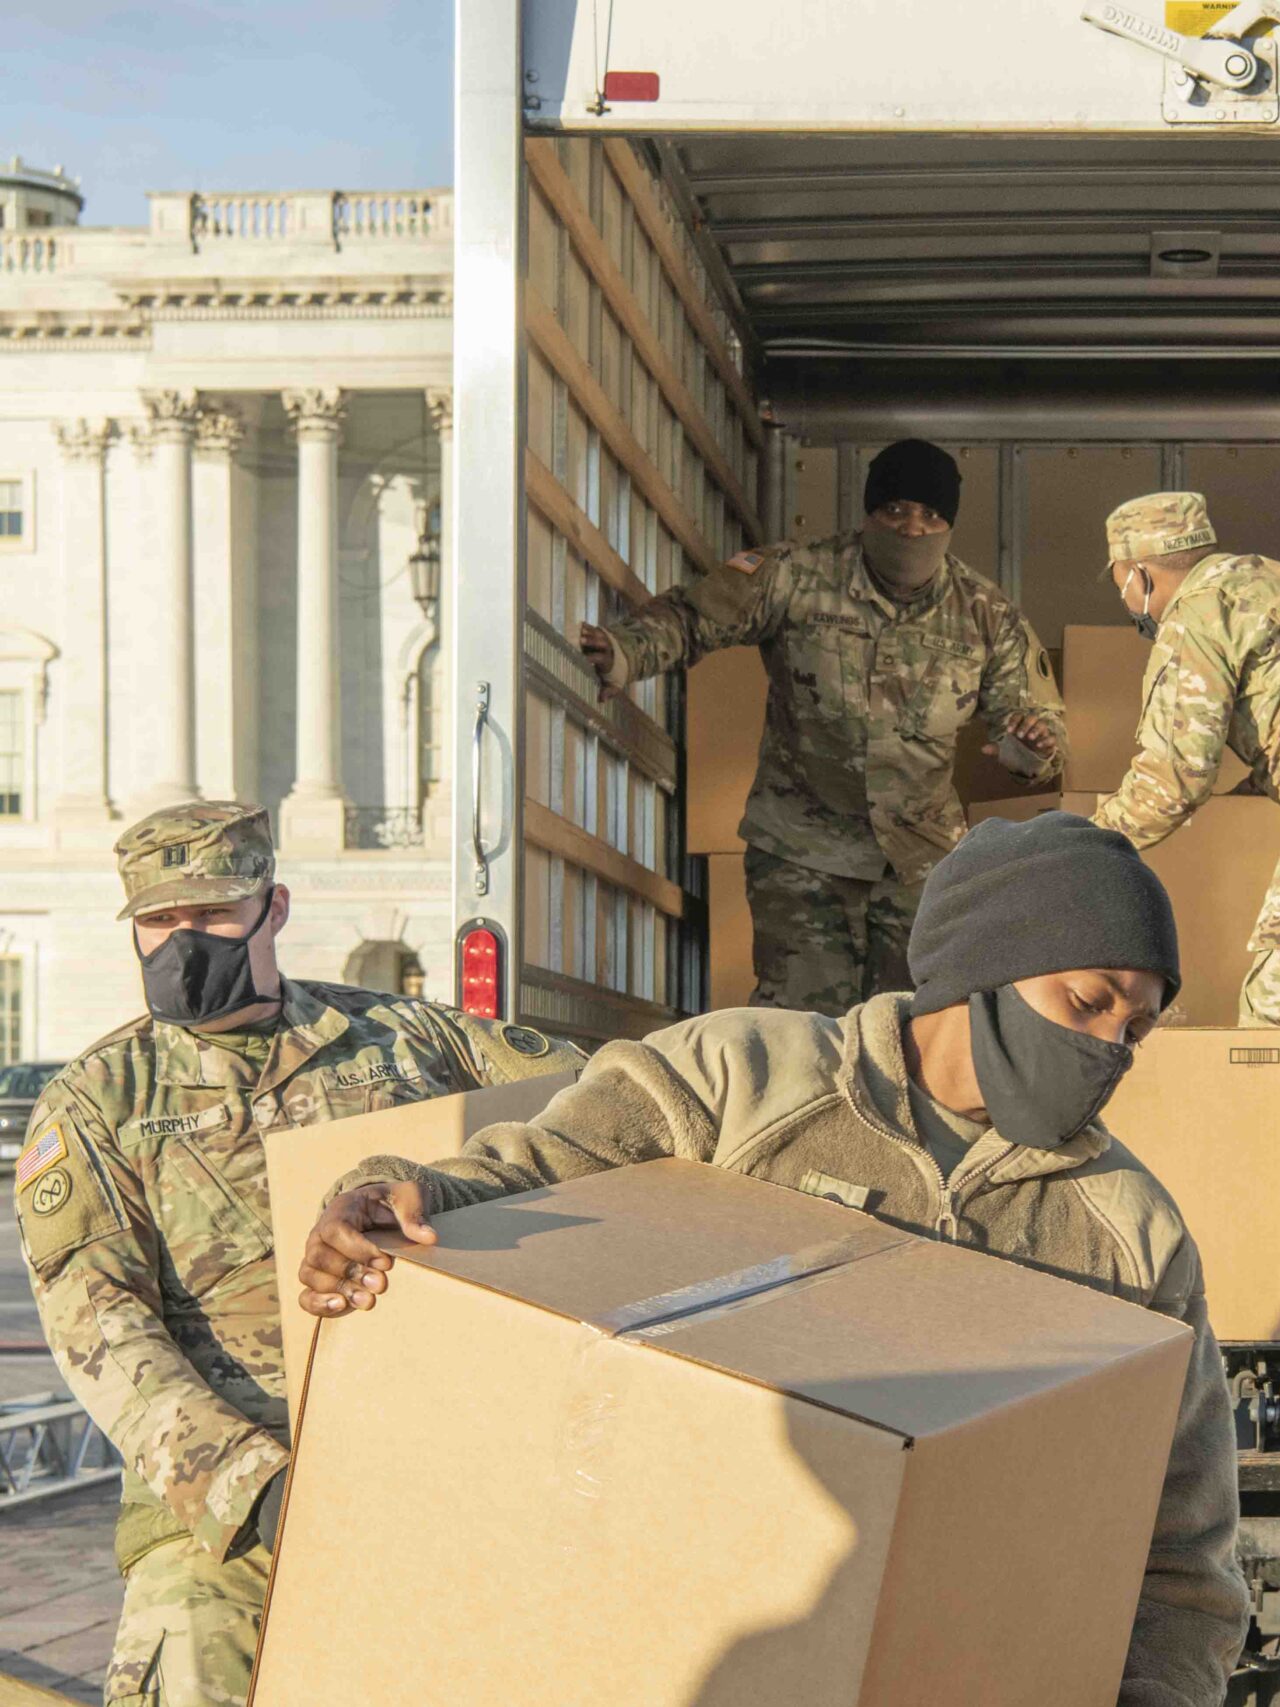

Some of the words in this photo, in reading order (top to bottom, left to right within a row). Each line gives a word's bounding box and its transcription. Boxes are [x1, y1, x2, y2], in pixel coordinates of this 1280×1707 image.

[336, 1073, 364, 1087] U.S.
[368, 1063, 401, 1081] ARMY
[140, 1114, 200, 1137] MURPHY
